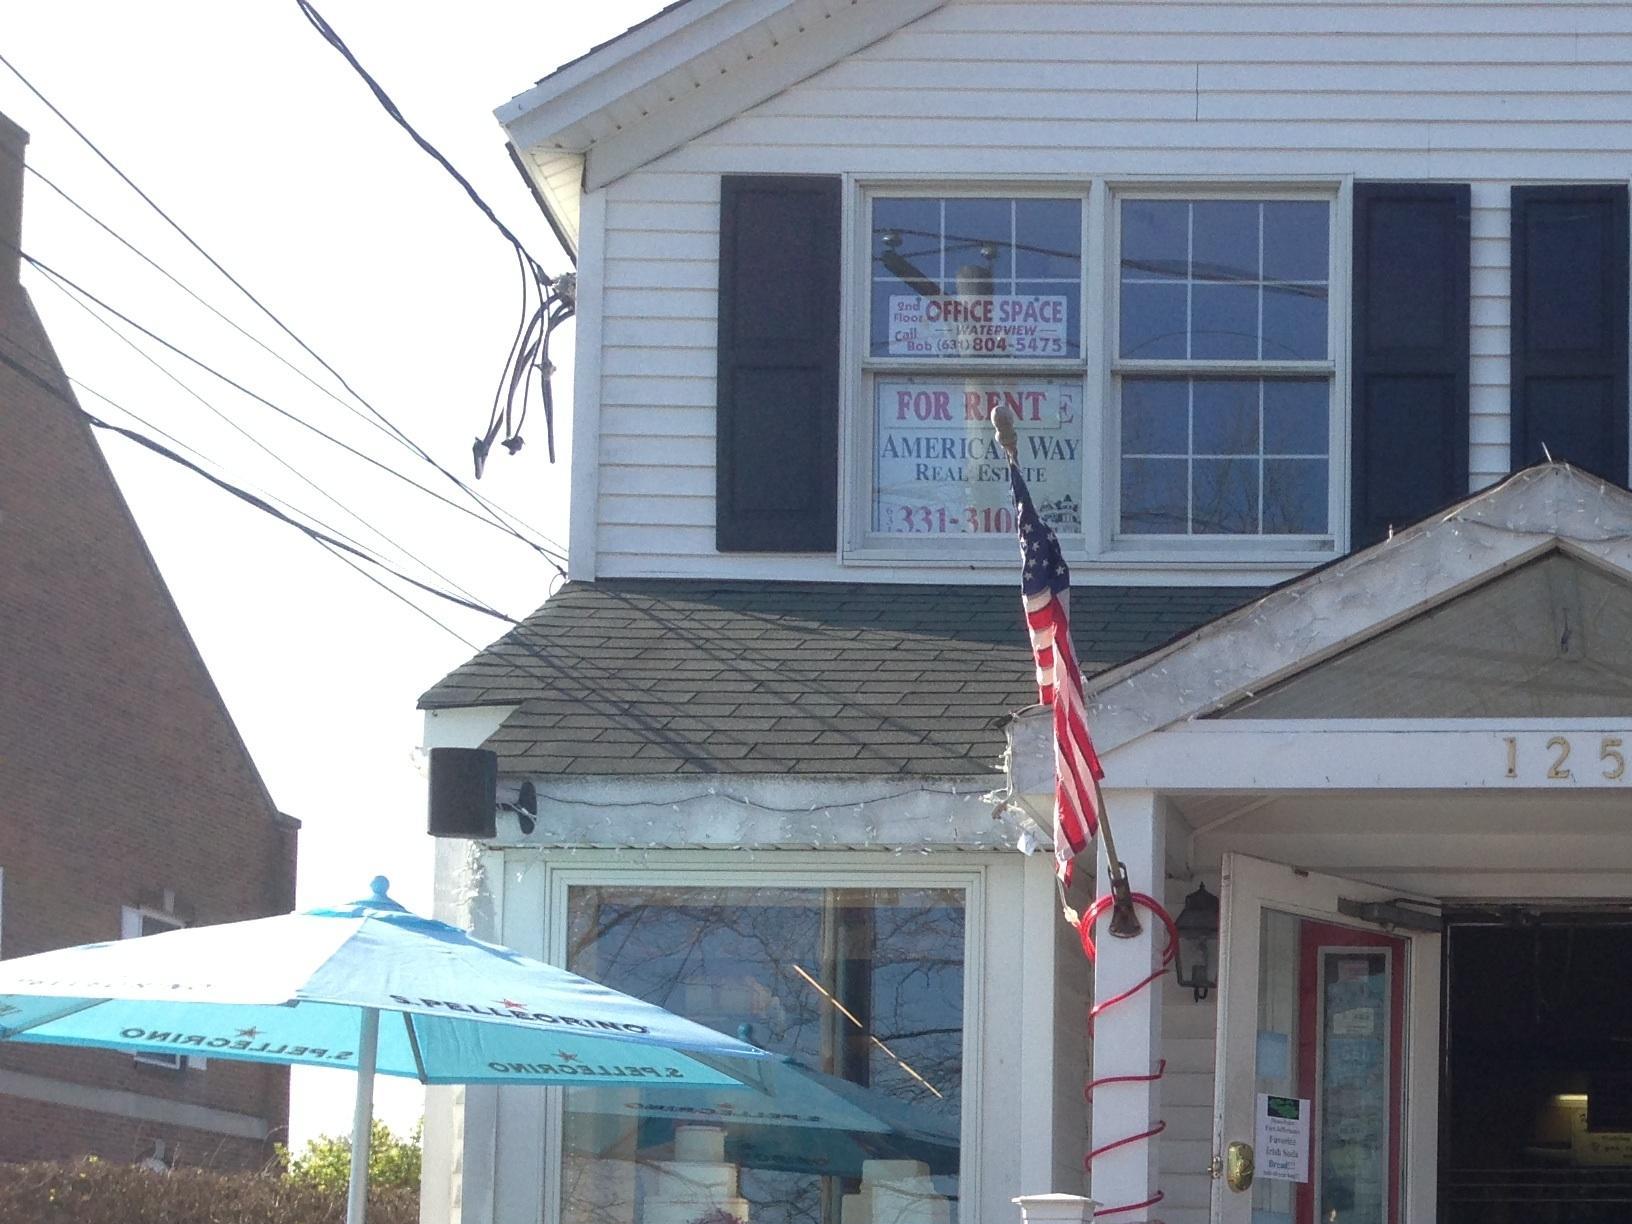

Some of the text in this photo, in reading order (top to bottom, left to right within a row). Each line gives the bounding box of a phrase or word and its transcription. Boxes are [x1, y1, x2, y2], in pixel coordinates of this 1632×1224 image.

[897, 301, 920, 311] 2nd
[926, 300, 1063, 323] OFFICE SPACE
[895, 328, 917, 342] Call
[955, 324, 1037, 336] WATERVIEW
[906, 340, 932, 352] Bob
[972, 338, 1062, 352] 804-5475
[896, 391, 1047, 421] FOR RENT
[881, 433, 1081, 461] AMERICA WAY
[915, 463, 1048, 482] REAL ESTTE
[897, 506, 1018, 533] 331-310
[1502, 735, 1625, 780] 125
[390, 994, 648, 1034] S.PELLEGRINO
